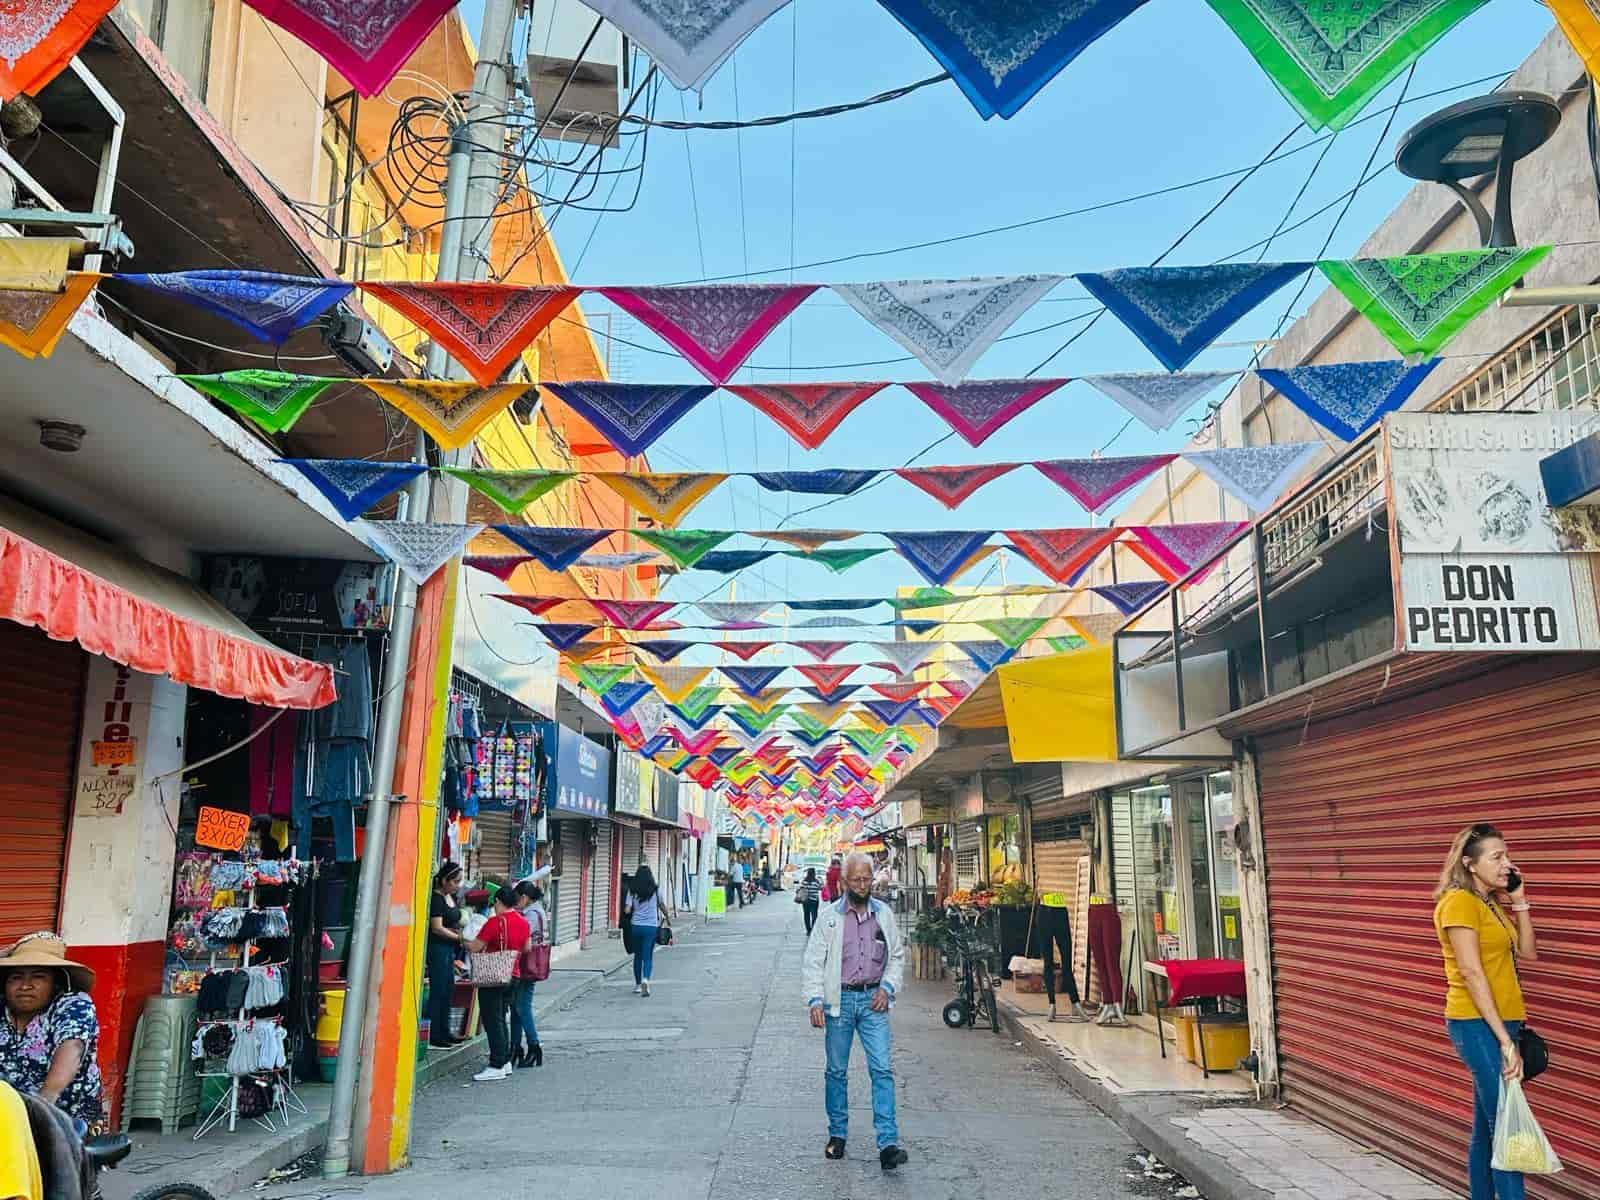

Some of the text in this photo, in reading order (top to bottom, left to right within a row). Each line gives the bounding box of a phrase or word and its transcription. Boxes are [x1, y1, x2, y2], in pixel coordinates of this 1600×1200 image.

[1442, 565, 1515, 601] DON
[1408, 607, 1558, 644] PEDRITO
[200, 808, 246, 832] BOXER
